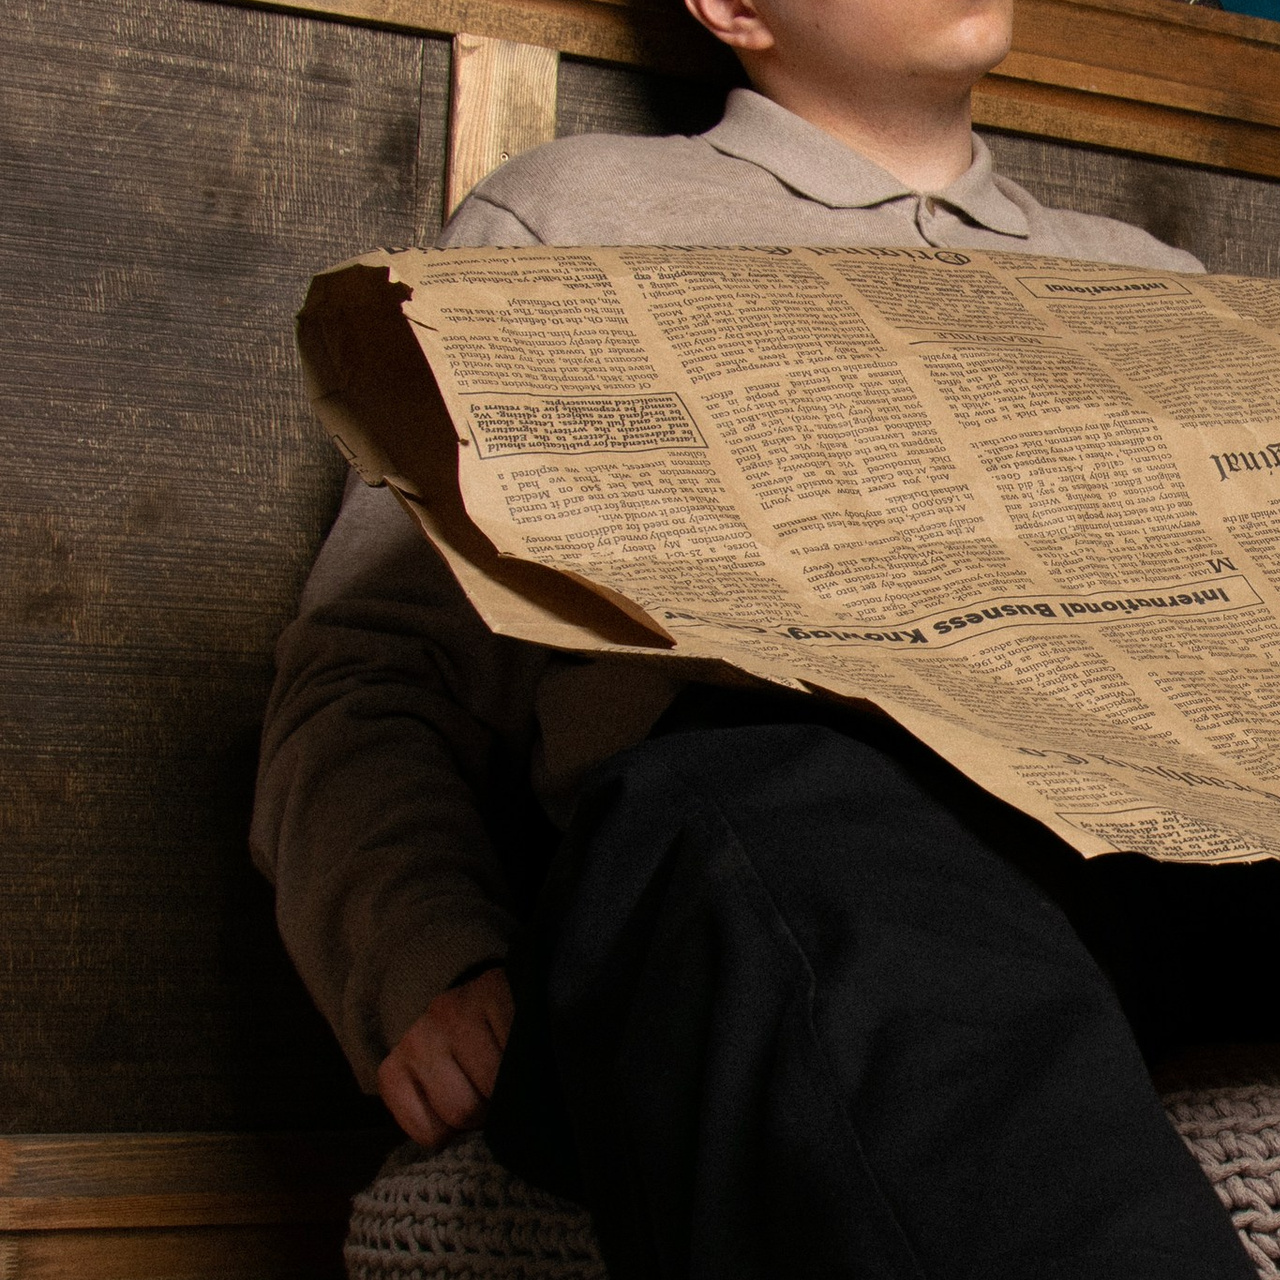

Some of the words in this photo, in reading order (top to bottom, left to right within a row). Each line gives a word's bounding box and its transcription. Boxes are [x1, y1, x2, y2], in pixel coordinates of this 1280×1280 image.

[1045, 281, 1169, 295] International
[614, 397, 673, 406] unsolicited
[470, 404, 480, 413] of
[641, 403, 677, 411] cannot
[496, 411, 537, 419] editing.
[556, 412, 594, 420] subject
[558, 419, 603, 427] address.
[607, 419, 626, 427] full
[622, 430, 676, 440] addressed
[488, 442, 526, 452] should
[528, 439, 590, 450] publication
[593, 439, 608, 447] for
[610, 439, 658, 449] intended
[511, 465, 559, 480] explored
[585, 463, 619, 474] which
[659, 469, 716, 477] Convention
[518, 480, 540, 490] had
[580, 484, 601, 493] $40
[930, 484, 969, 495] Michael
[558, 486, 573, 494] on
[647, 487, 677, 495] down
[504, 489, 550, 505] Medical
[607, 492, 619, 500] to
[550, 500, 560, 509] it
[563, 496, 585, 508] and
[603, 502, 619, 511] for
[620, 498, 660, 510] waiting
[509, 503, 548, 516] turned
[558, 509, 581, 518] race
[583, 505, 602, 513] the
[821, 511, 840, 520] will
[844, 509, 882, 519] anybody
[512, 515, 542, 525] start,
[626, 524, 640, 532] for
[643, 520, 669, 530] need
[565, 524, 623, 542] additional
[650, 526, 697, 540] probably
[522, 535, 562, 544] money,
[597, 537, 611, 549] by
[613, 533, 648, 545] owned
[528, 546, 553, 554] with
[555, 542, 595, 551] doctors
[1063, 587, 1230, 618] International
[932, 601, 1057, 636] Busness
